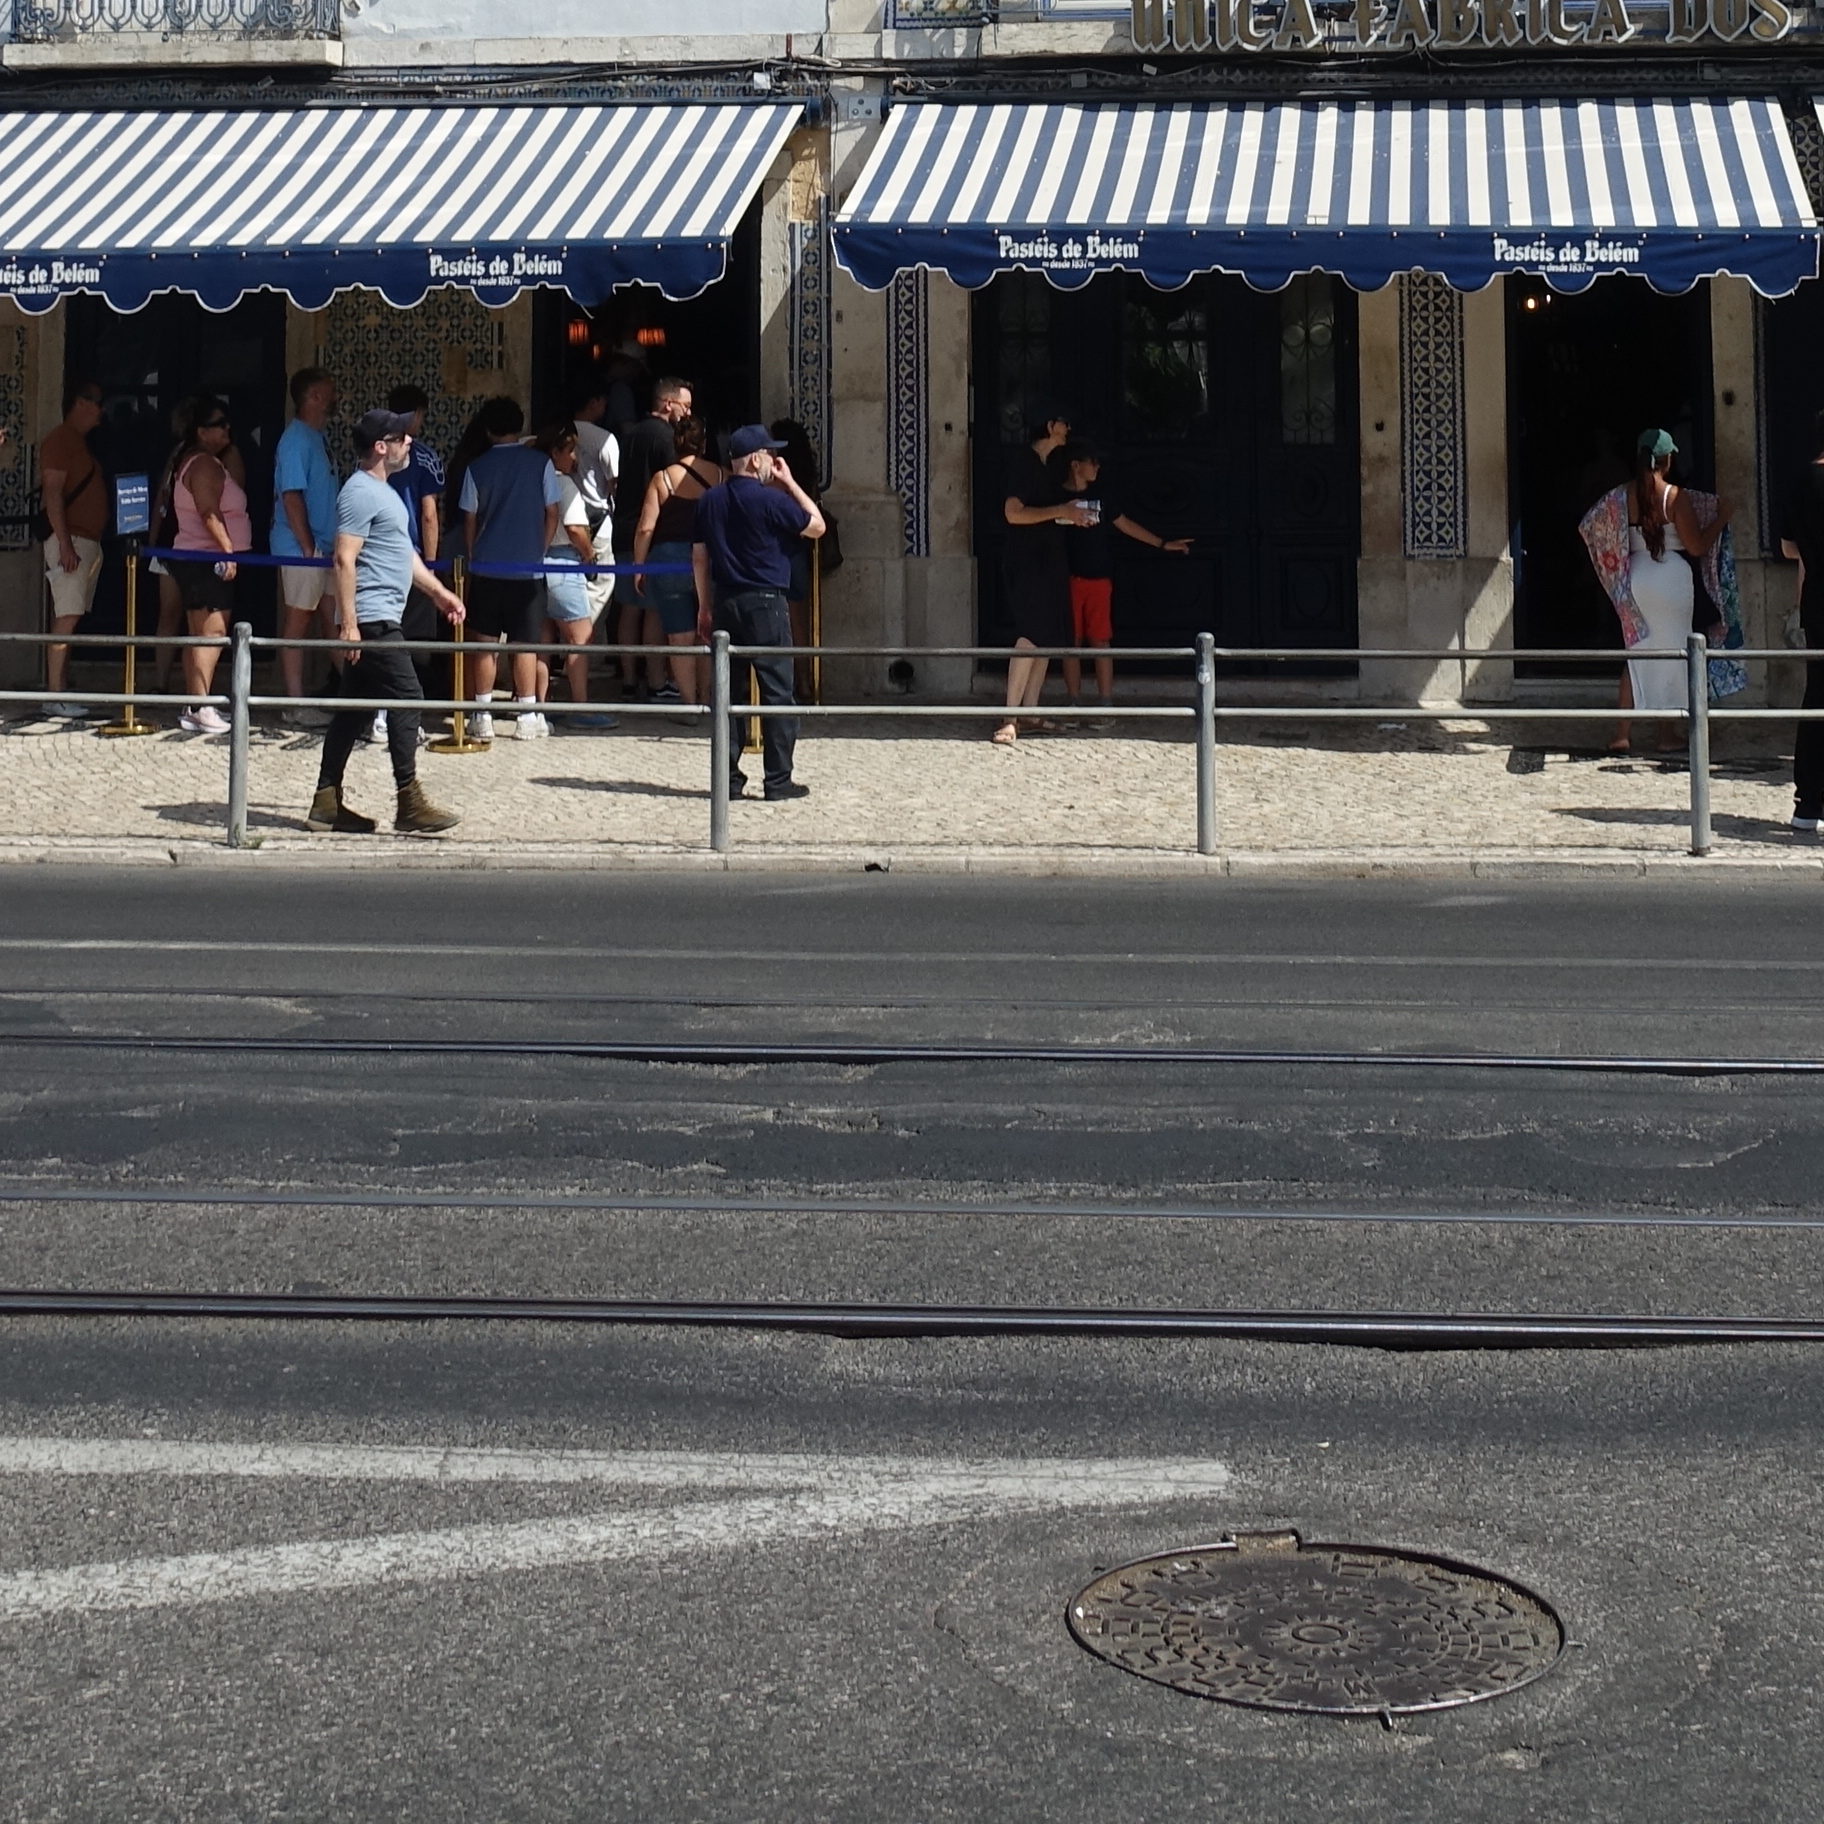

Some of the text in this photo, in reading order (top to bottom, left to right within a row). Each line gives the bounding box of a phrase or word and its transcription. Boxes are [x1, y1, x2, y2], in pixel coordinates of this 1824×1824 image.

[999, 235, 1139, 258] Pastéis de Belém
[1494, 238, 1640, 262] Pastéis de Belém
[430, 252, 562, 277] Pastéis de Belém
[1050, 259, 1088, 268] desde 1837
[1547, 263, 1586, 272] desde 1837
[28, 264, 48, 284] de
[51, 262, 100, 284] Belém
[478, 276, 514, 286] desde 1837
[18, 284, 53, 294] desde 1837
